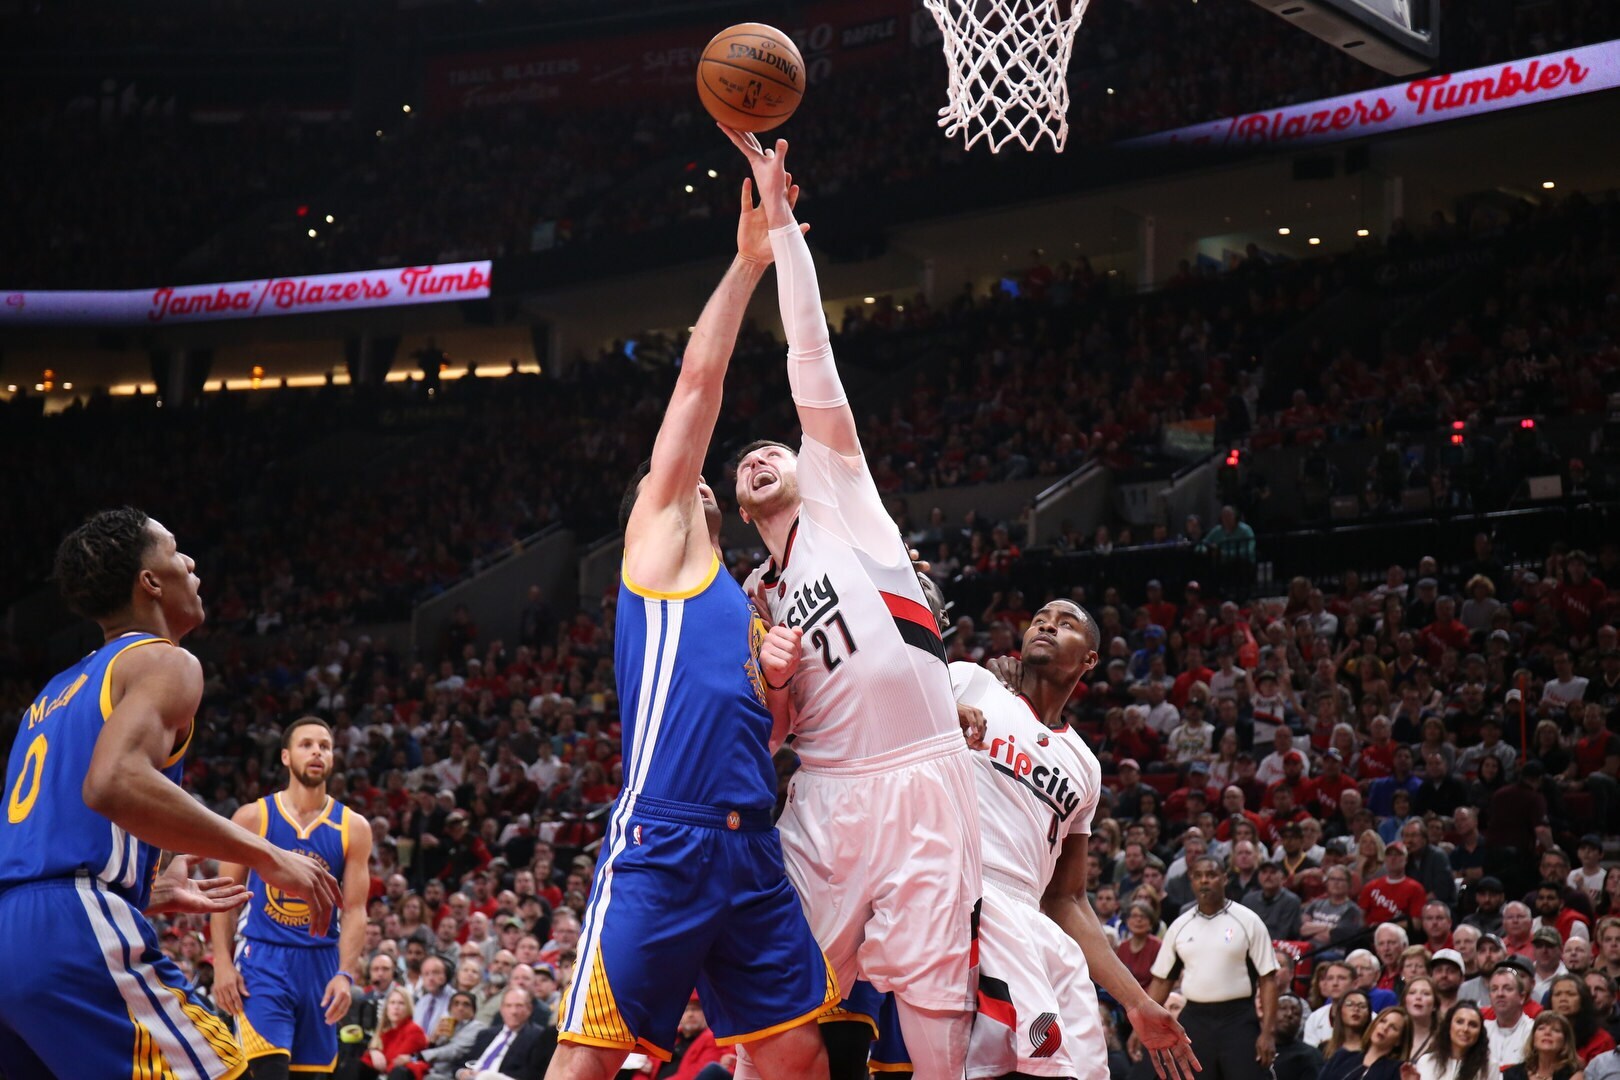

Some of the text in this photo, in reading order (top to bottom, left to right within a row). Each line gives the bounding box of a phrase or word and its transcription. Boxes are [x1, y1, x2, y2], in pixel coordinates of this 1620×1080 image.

[727, 43, 799, 83] SPALDING
[1406, 56, 1589, 115] Tumbler
[401, 265, 491, 297] Tumb
[810, 609, 859, 673] 27
[8, 733, 48, 824] 0
[264, 902, 311, 927] WARRIO
